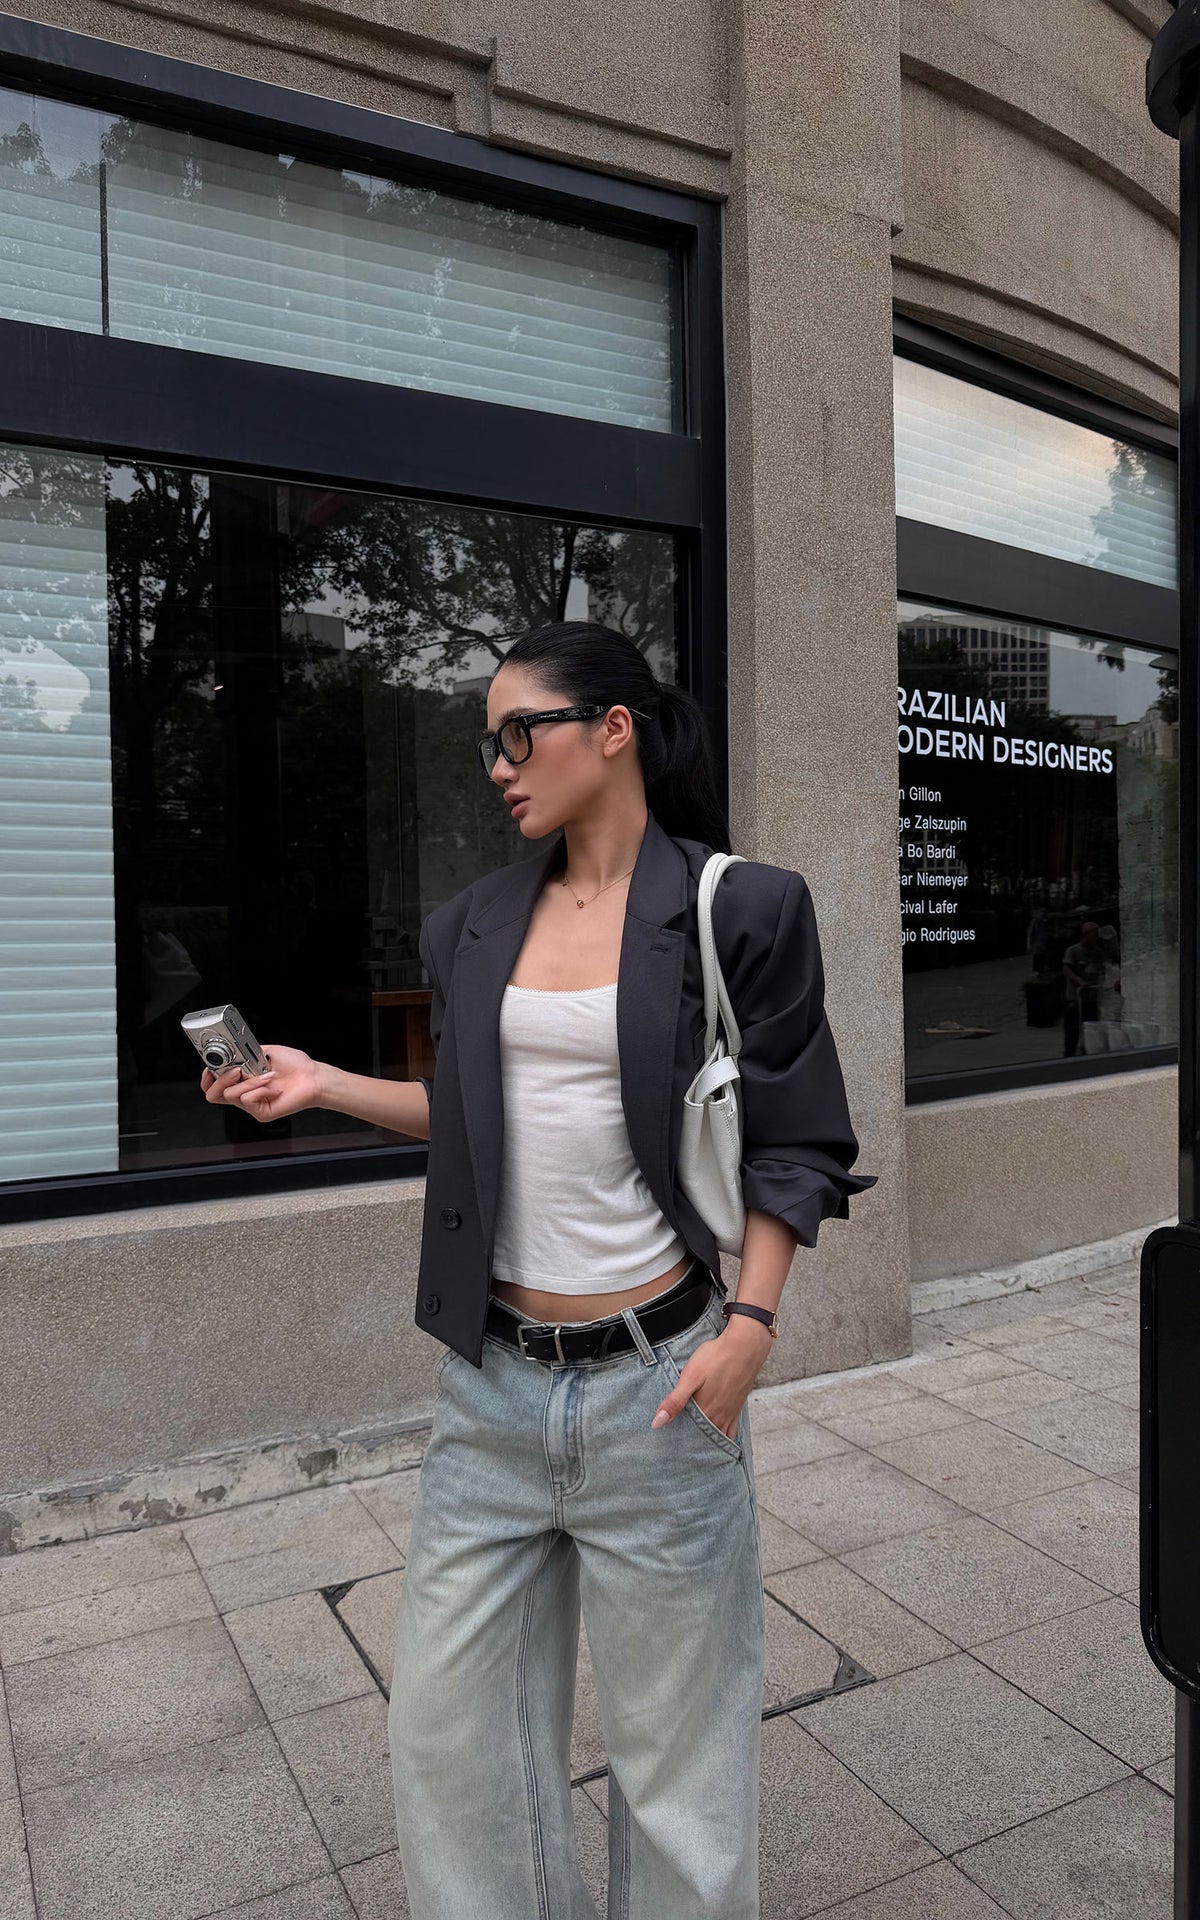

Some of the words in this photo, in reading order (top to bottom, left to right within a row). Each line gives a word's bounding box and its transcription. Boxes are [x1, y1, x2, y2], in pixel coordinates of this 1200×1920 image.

[898, 686, 1006, 728] RAZILIAN
[898, 725, 984, 761] ODERN
[993, 735, 1114, 774] DESIGNERS
[909, 786, 942, 802] Gillon
[914, 815, 967, 834] Zalszupin
[907, 843, 923, 858] Bo
[926, 844, 956, 859] Bardi
[916, 872, 969, 890] Niemeyer
[900, 899, 925, 914] cival
[928, 899, 958, 914] Lafer
[901, 928, 917, 946] gio
[920, 927, 976, 945] Rodrigues
